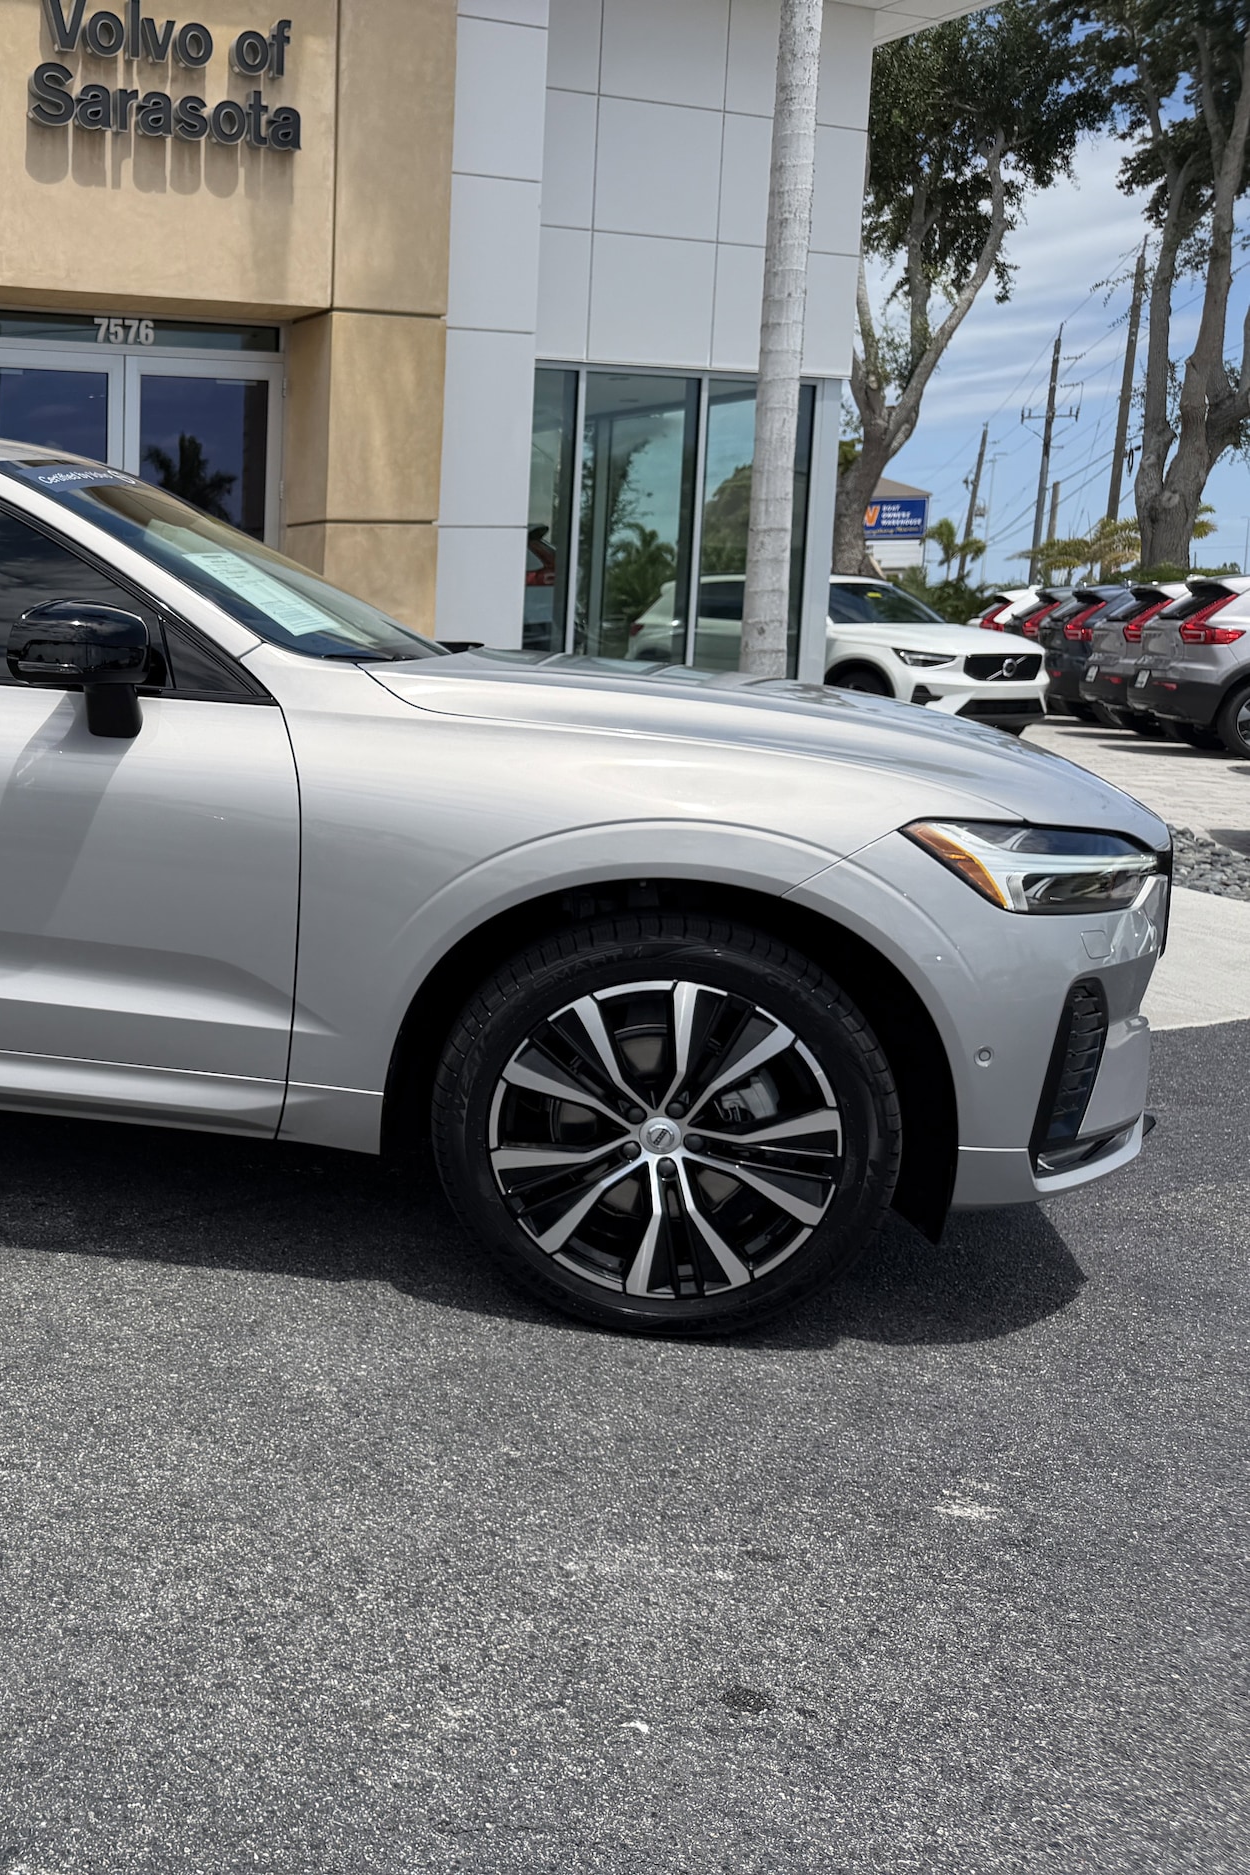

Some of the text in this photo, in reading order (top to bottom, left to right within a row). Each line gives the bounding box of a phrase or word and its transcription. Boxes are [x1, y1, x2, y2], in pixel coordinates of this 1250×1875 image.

[44, 0, 292, 79] Volvo of
[27, 62, 302, 151] Sarasota
[93, 317, 155, 346] 7576
